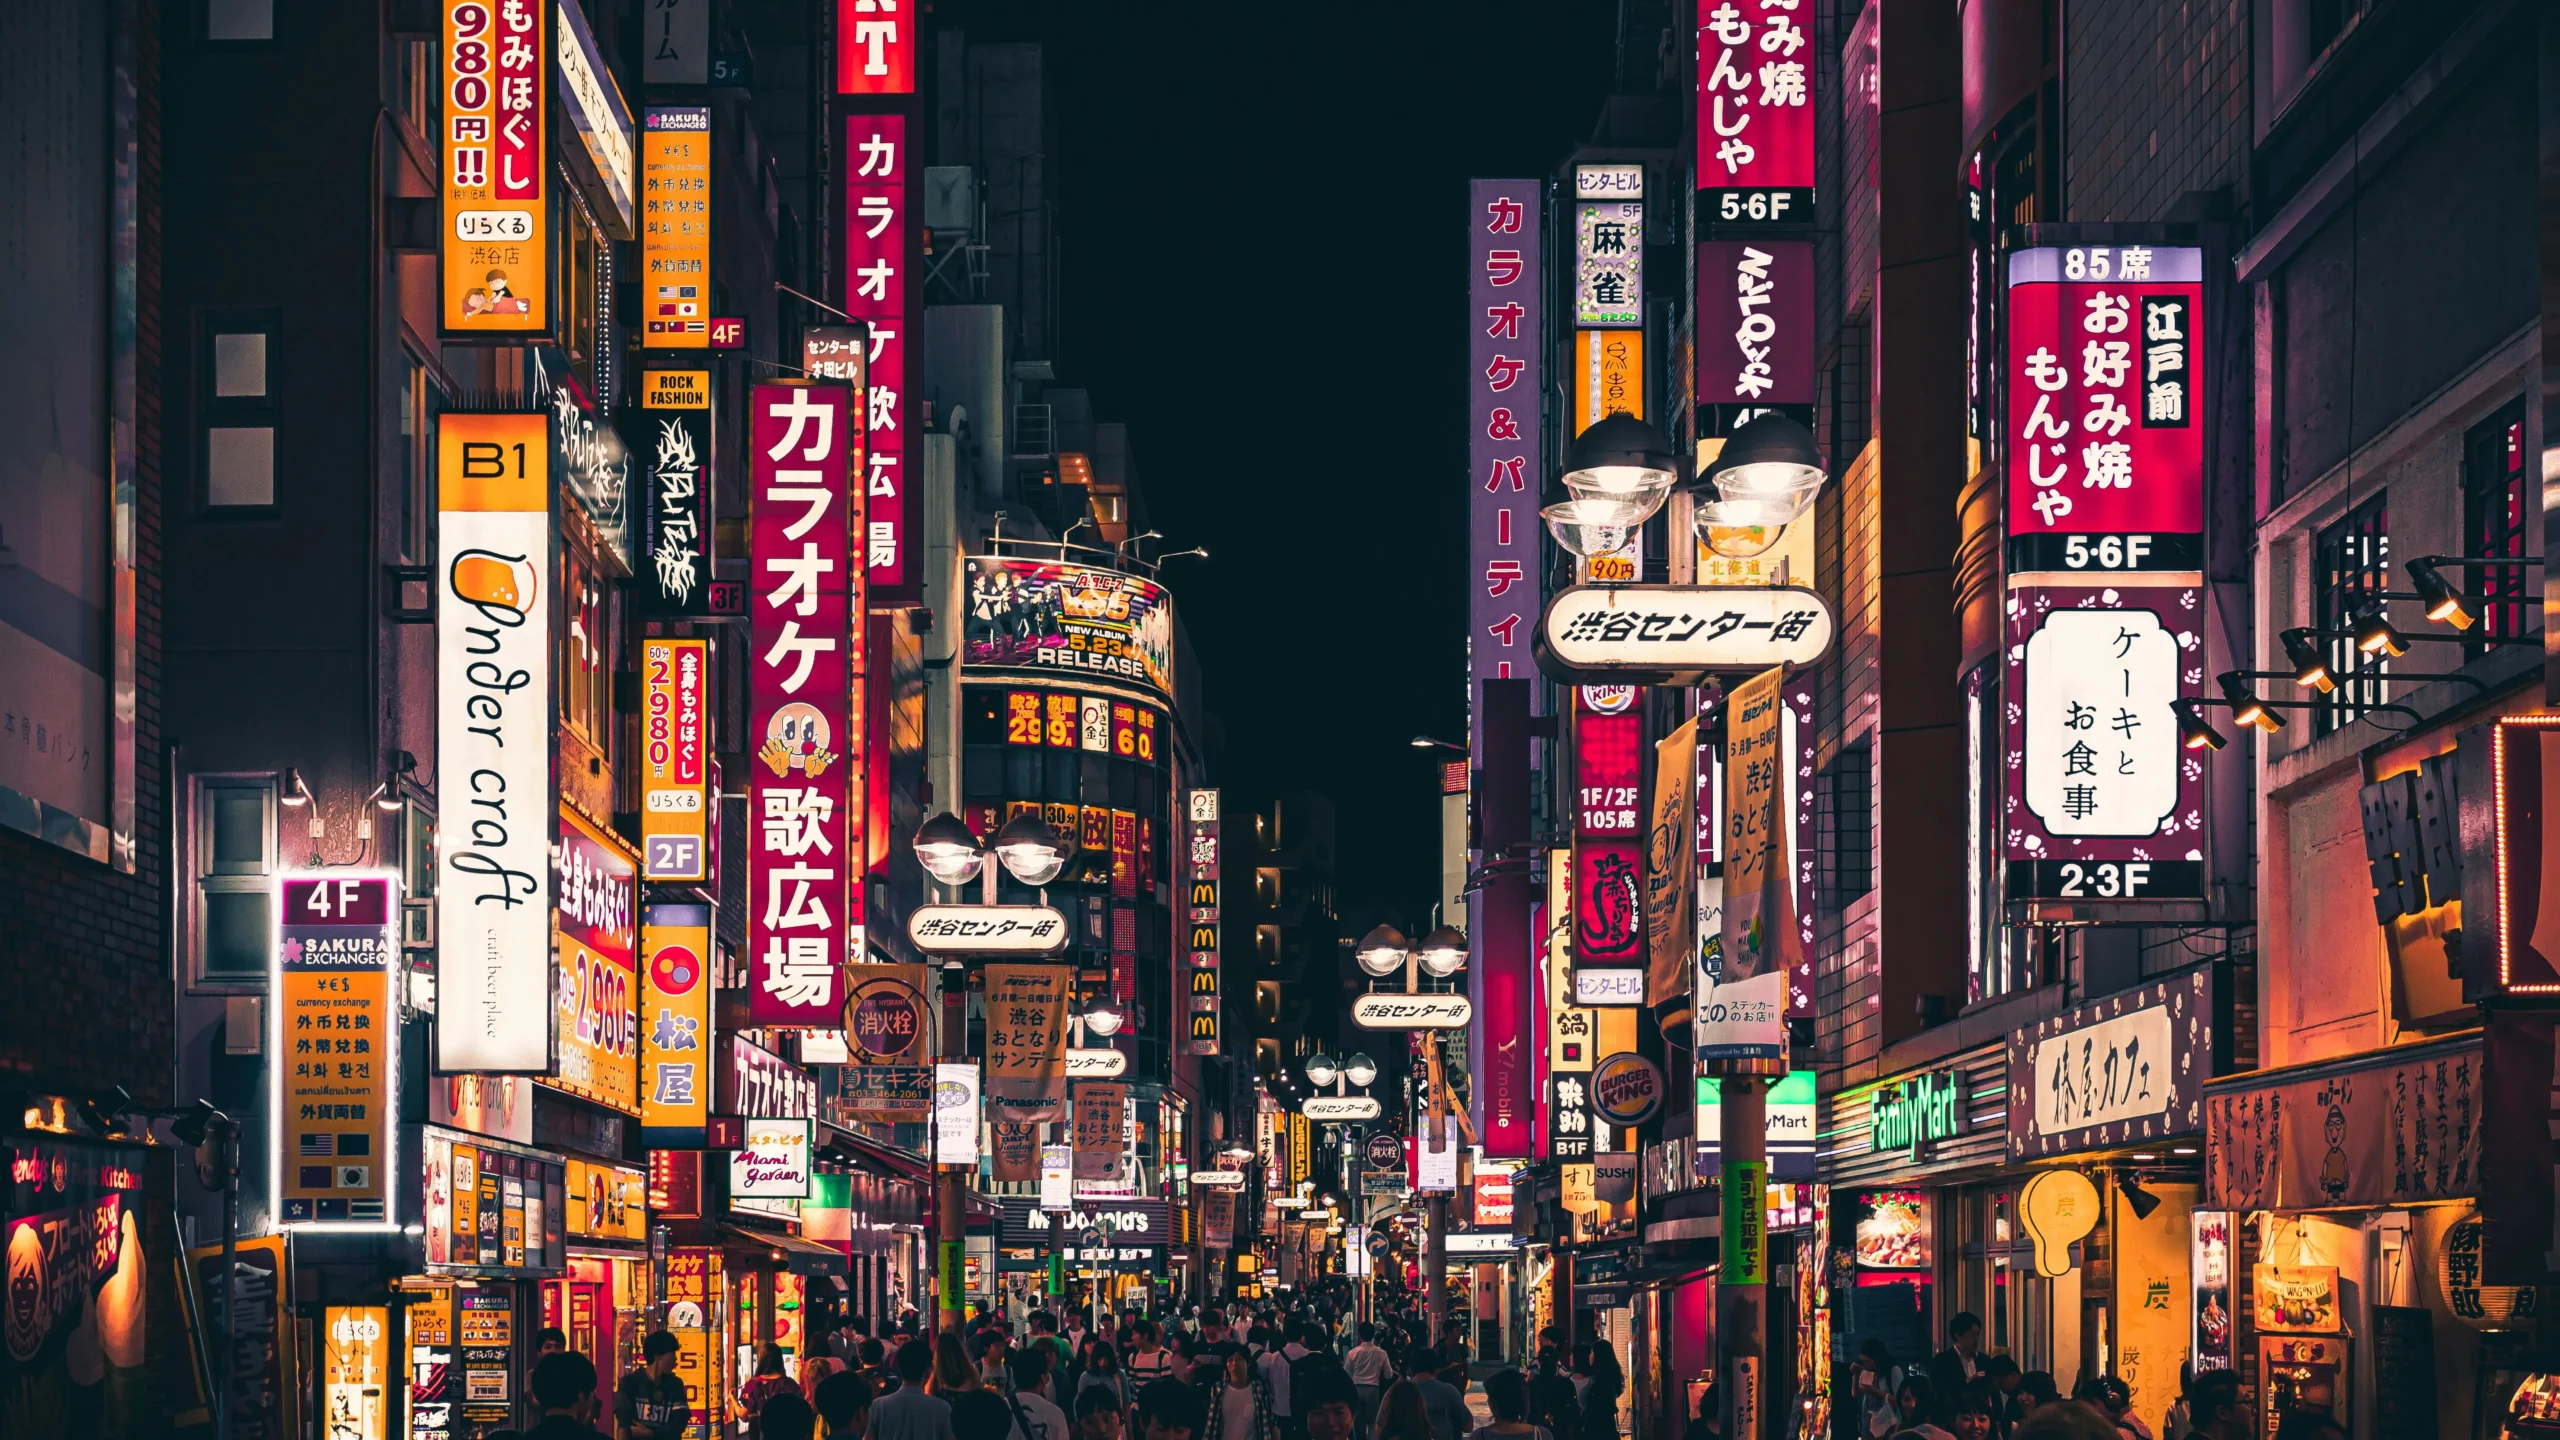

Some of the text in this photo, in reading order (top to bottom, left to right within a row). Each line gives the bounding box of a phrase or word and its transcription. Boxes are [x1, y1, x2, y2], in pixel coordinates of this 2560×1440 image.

[1759, 0, 1807, 107] み焼
[1707, 2, 1755, 174] もんじゃ
[661, 114, 707, 123] SAKURA
[1578, 172, 1642, 192] センタービル
[1622, 205, 1641, 217] 5F
[463, 217, 526, 235] りらくる
[470, 246, 520, 265] 渋谷店
[651, 258, 703, 273] 外貨両替
[1592, 221, 1626, 305] 麻雀
[712, 324, 741, 343] 4F
[2147, 303, 2183, 421] 江戸前
[659, 376, 694, 390] ROCK
[2083, 291, 2132, 489] お好み焼
[650, 391, 703, 405] FASHION
[2023, 346, 2073, 526] もんじゃ
[462, 442, 527, 479] B1
[1709, 560, 1761, 576] 北海道
[714, 587, 739, 610] 3F
[1065, 624, 1126, 642] NEW ALBUM
[1561, 610, 1819, 643] 渋谷センター街
[1069, 634, 1123, 657] 5.23
[1037, 647, 1144, 678] RELEASE
[2112, 626, 2142, 776] ケーキと
[680, 652, 698, 779] 全身もみほぐし
[1099, 702, 1108, 749] やきとり
[2062, 700, 2099, 820] お食事
[1746, 757, 1775, 796] 渋谷
[652, 795, 697, 808] りらくる
[1047, 806, 1076, 824] 30分
[1583, 810, 1636, 829] 105席
[450, 769, 538, 911] craft
[655, 843, 694, 869] 2F
[306, 879, 361, 918] 4F
[559, 836, 634, 951] 全身もみほぐし
[916, 918, 1058, 938] 渋谷センター街
[305, 938, 388, 953] SAKURA
[1578, 977, 1641, 995] センタービル
[296, 998, 371, 1010] currency exchange
[1361, 1004, 1468, 1018] 渋谷センター街
[1699, 1004, 1728, 1024] この
[1730, 1001, 1775, 1011] ステッカー
[859, 1010, 913, 1035] 消火栓
[1009, 1007, 1046, 1027] 渋谷
[992, 1030, 1061, 1047] おとなり
[651, 1008, 699, 1106] 松屋
[991, 1051, 1061, 1068] サンデー
[296, 1062, 371, 1079] 외화 환전
[1600, 1068, 1651, 1094] BURGER
[2051, 1035, 2152, 1127] 椿屋カフェ
[856, 1089, 923, 1099] 03-3464-2061
[995, 1096, 1058, 1107] Panasonic
[1602, 1080, 1654, 1109] KING
[300, 1104, 367, 1121] 外貨両替
[1088, 1109, 1111, 1121] 渋谷
[1306, 1103, 1375, 1113] 渋谷センター街
[1870, 1070, 1958, 1162] FamilyMart
[734, 1151, 790, 1167] Miami
[1371, 1146, 1398, 1160] 消火栓
[1556, 1142, 1588, 1157] B1F
[101, 1165, 144, 1191] Kitchen
[1563, 1168, 1595, 1188] すし
[1596, 1167, 1635, 1179] SUSHI
